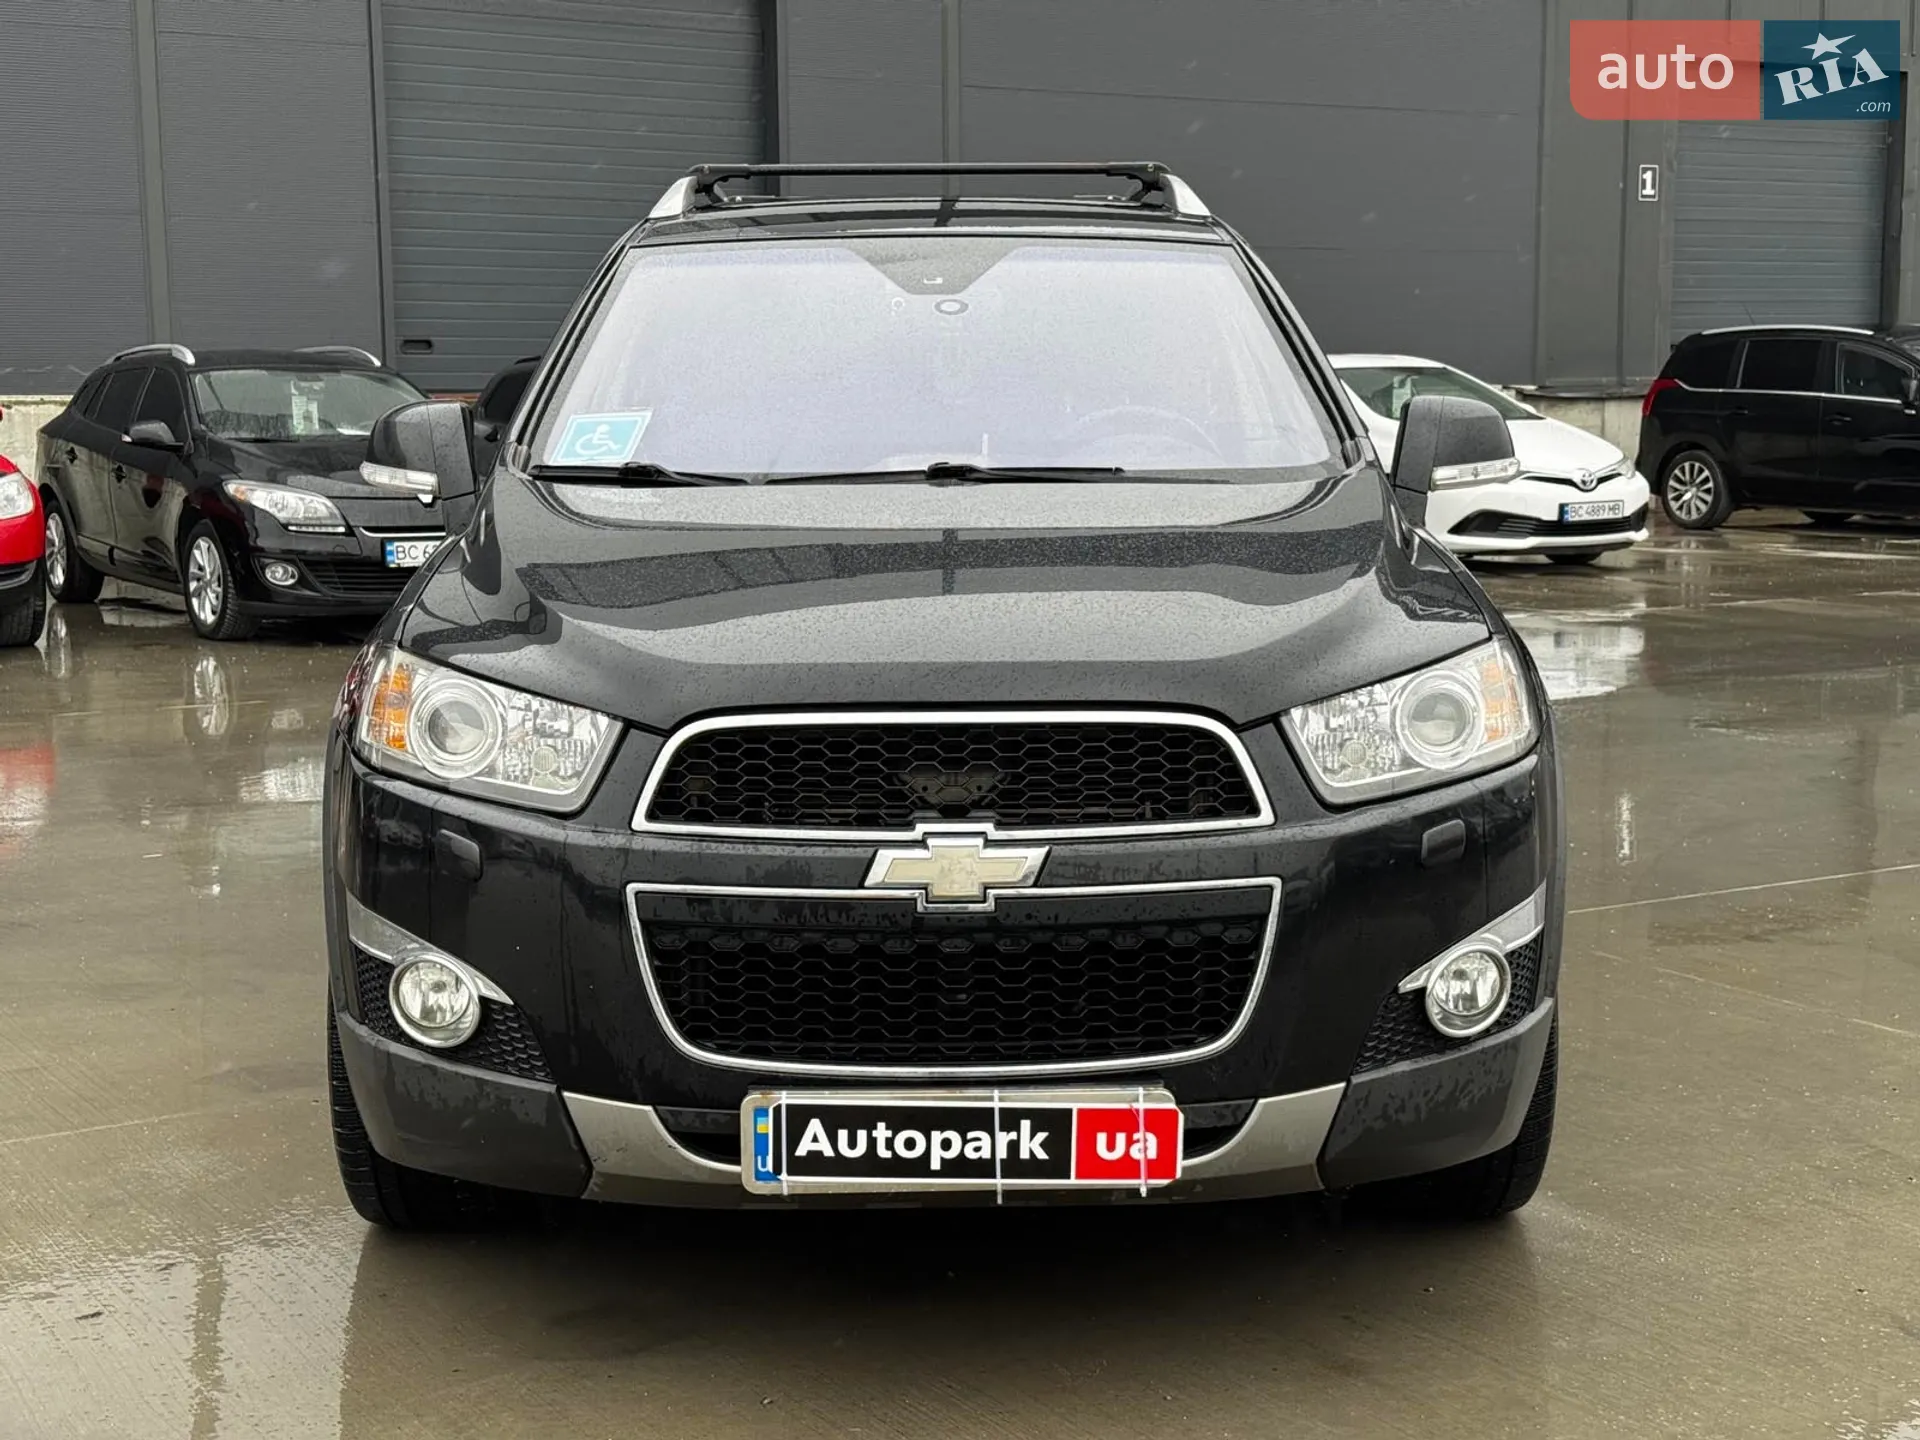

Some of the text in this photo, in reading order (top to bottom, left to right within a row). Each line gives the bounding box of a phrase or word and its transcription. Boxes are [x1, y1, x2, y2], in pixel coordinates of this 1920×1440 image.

[1642, 170, 1656, 196] 1
[1570, 505, 1584, 519] BC
[395, 544, 419, 561] BC
[794, 1117, 1158, 1171] Autopark ua
